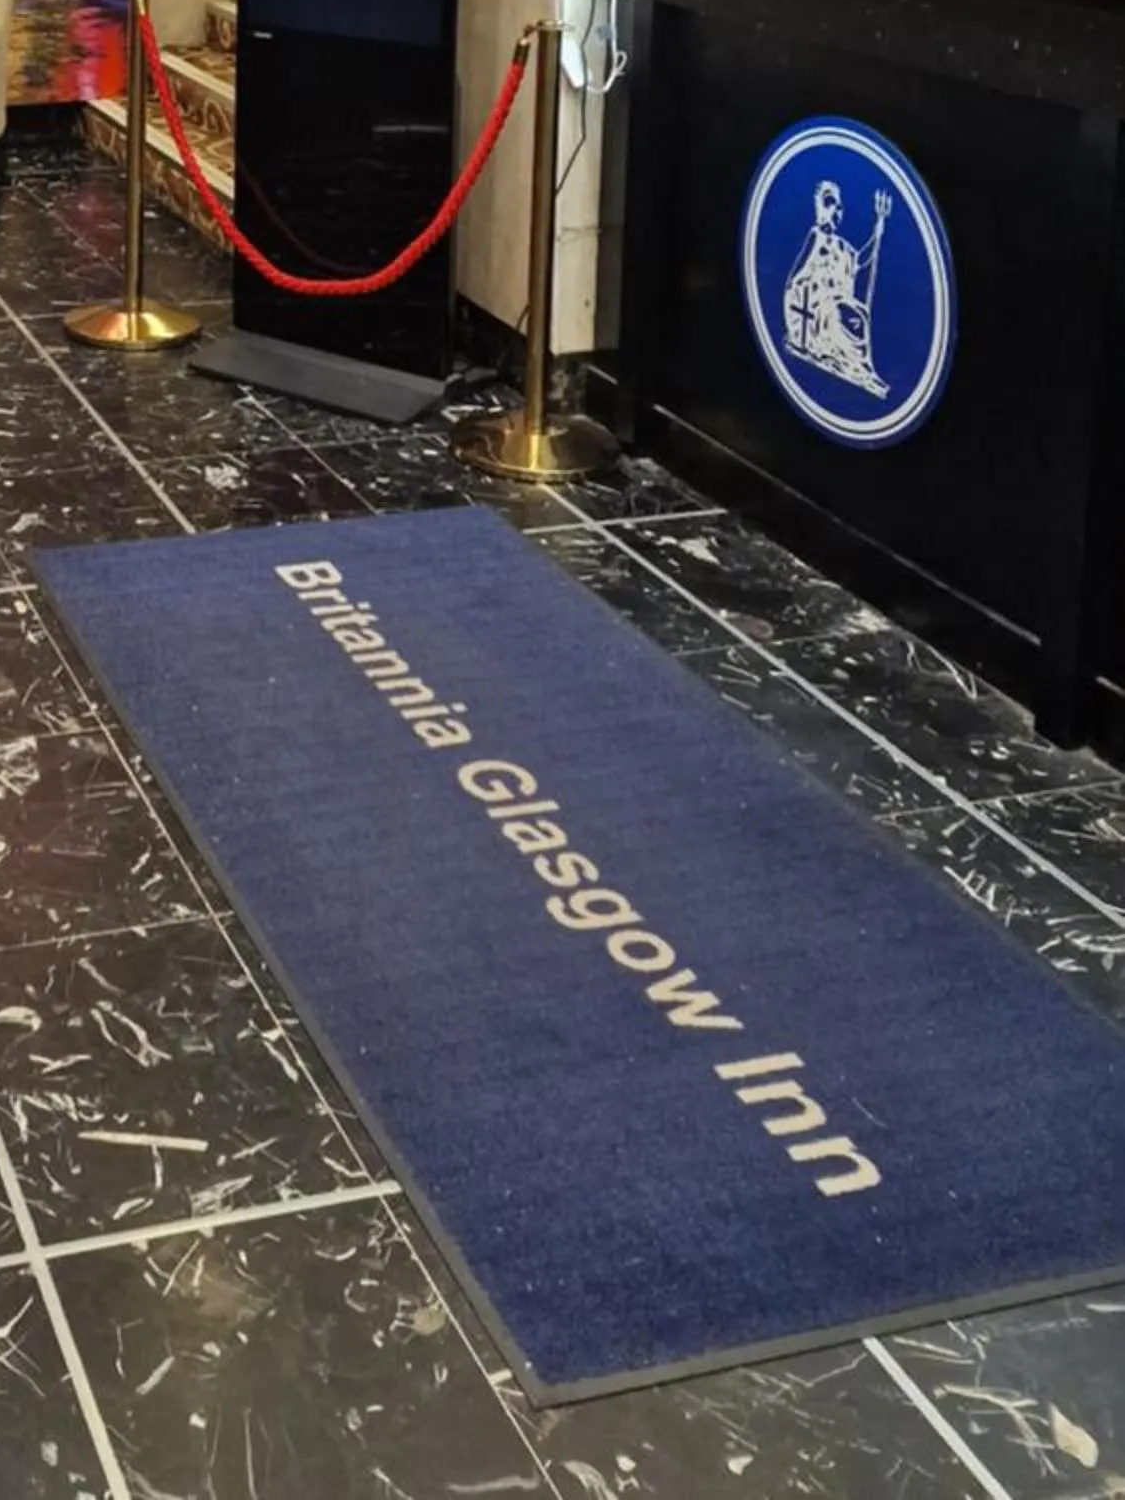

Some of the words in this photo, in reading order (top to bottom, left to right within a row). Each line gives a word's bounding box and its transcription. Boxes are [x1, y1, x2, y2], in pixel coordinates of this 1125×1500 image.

[275, 559, 472, 749] Britannia
[456, 759, 744, 1033] Glasgow
[713, 1051, 882, 1198] Inn
